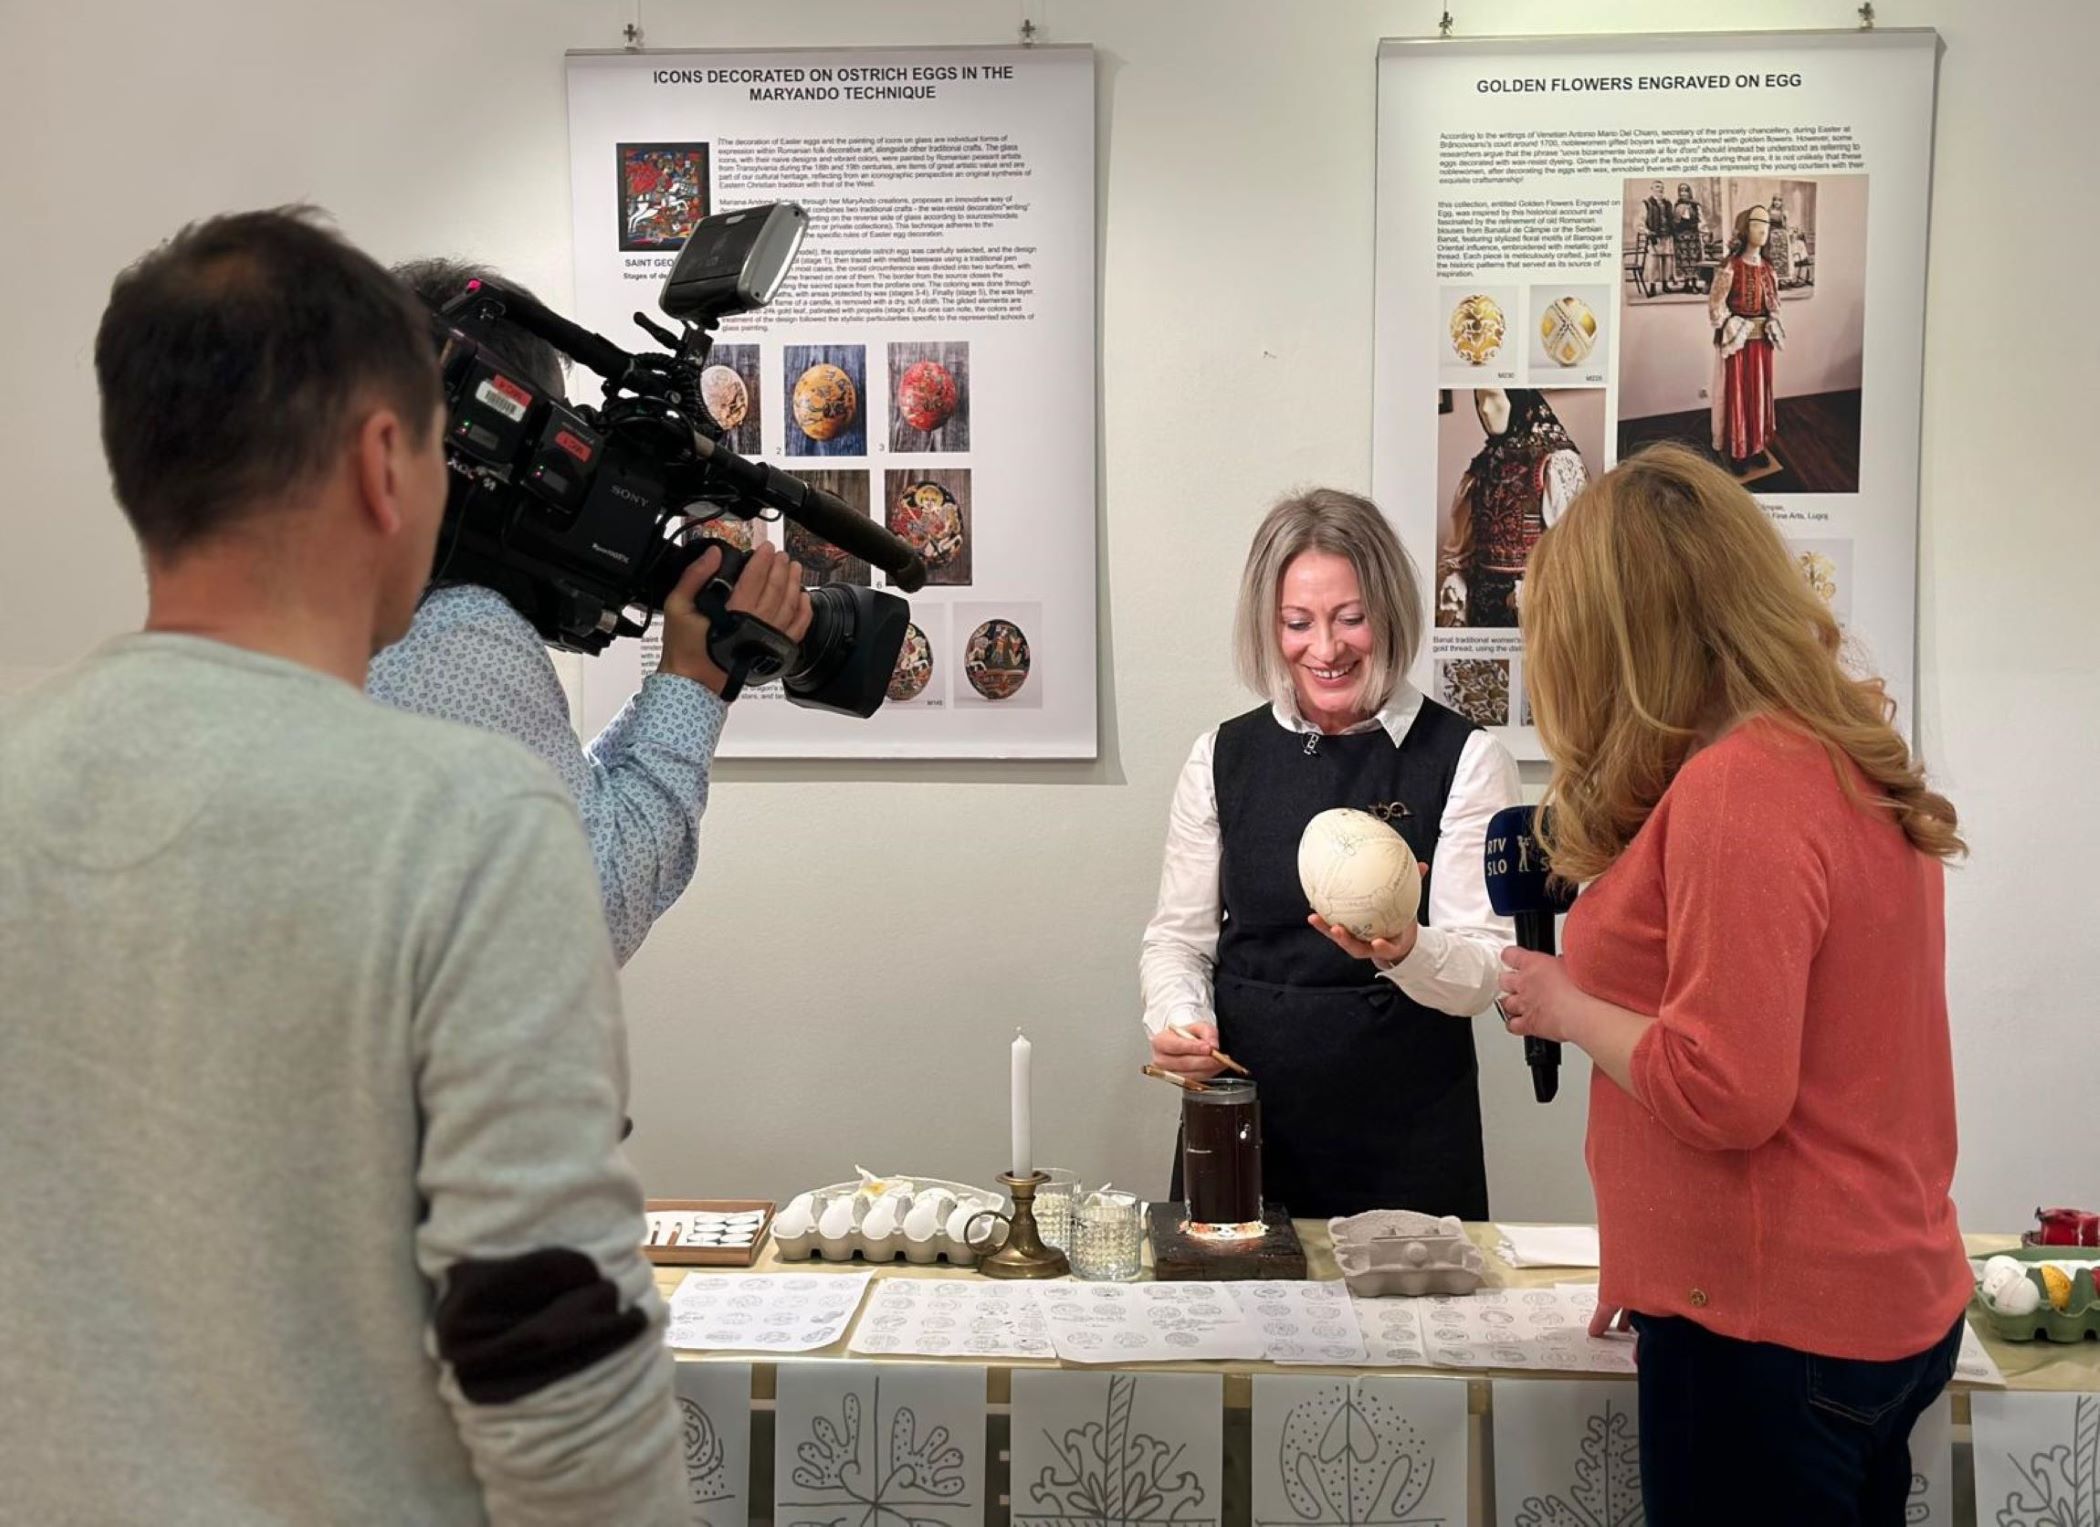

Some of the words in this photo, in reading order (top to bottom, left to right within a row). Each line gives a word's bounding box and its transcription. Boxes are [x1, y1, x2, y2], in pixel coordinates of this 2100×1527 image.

[654, 70, 702, 84] ICONS
[707, 69, 805, 83] DECORATED
[810, 69, 832, 82] ON
[837, 68, 907, 81] OSTRICH
[912, 67, 957, 80] EGGS
[962, 67, 977, 79] IN
[982, 66, 1013, 79] THE
[1476, 79, 1546, 93] GOLDEN
[1551, 78, 1632, 91] FLOWERS
[1638, 76, 1730, 90] ENGRAVED
[1735, 75, 1760, 88] ON
[1766, 74, 1801, 87] EGG
[750, 87, 839, 100] MARYANDO
[844, 86, 936, 100] TECHNIQUE
[1440, 132, 1475, 140] According
[1498, 132, 1525, 140] writings
[1660, 129, 1694, 137] secretary
[1792, 127, 1815, 135] during
[1739, 136, 1764, 145] golden
[1575, 200, 1609, 208] Engraved
[1592, 242, 1608, 250] gold
[610, 484, 648, 507] SONY
[1488, 838, 1506, 854] RTV
[1488, 859, 1507, 876] SLO
